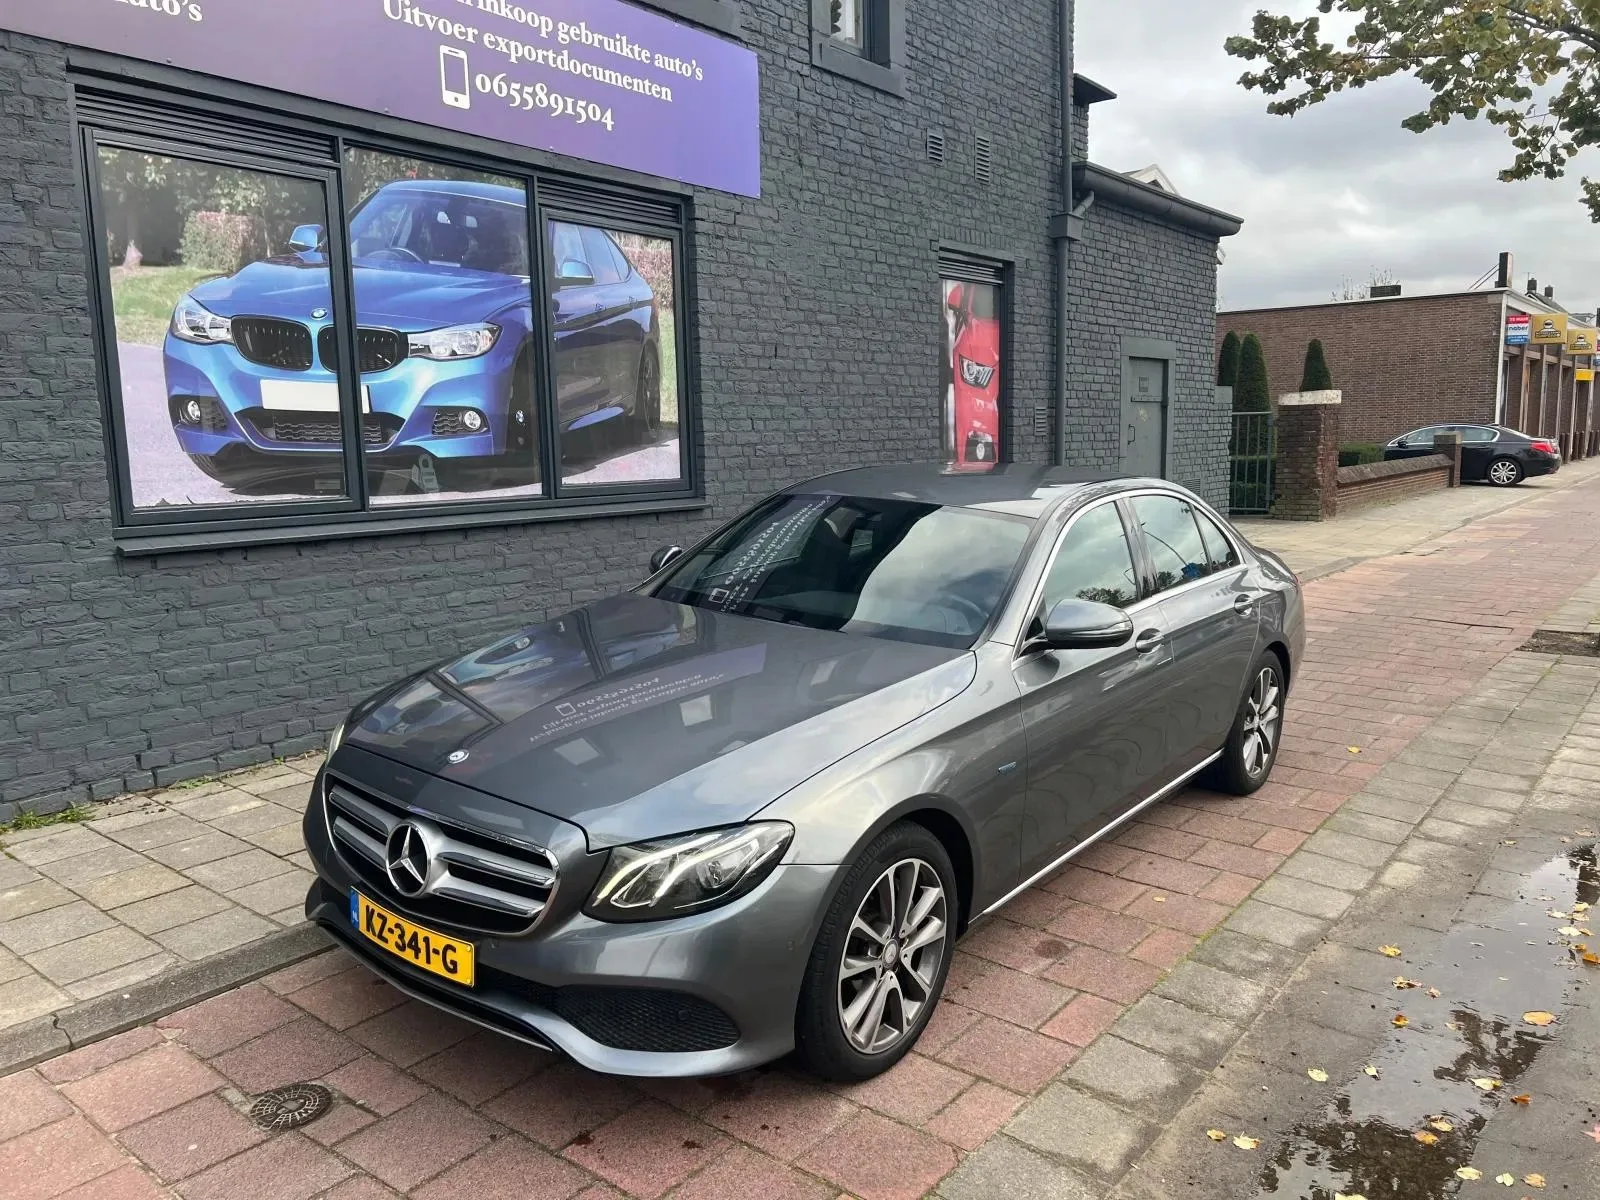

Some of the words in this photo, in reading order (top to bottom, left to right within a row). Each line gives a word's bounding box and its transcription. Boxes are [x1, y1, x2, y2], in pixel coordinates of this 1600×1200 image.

[383, 0, 478, 43] Uitvoer
[483, 32, 673, 102] exportdocumenten
[557, 20, 651, 64] gebruikte
[654, 53, 703, 82] auto's
[475, 73, 615, 131] 0655891504
[365, 904, 458, 974] KZ-341-G
